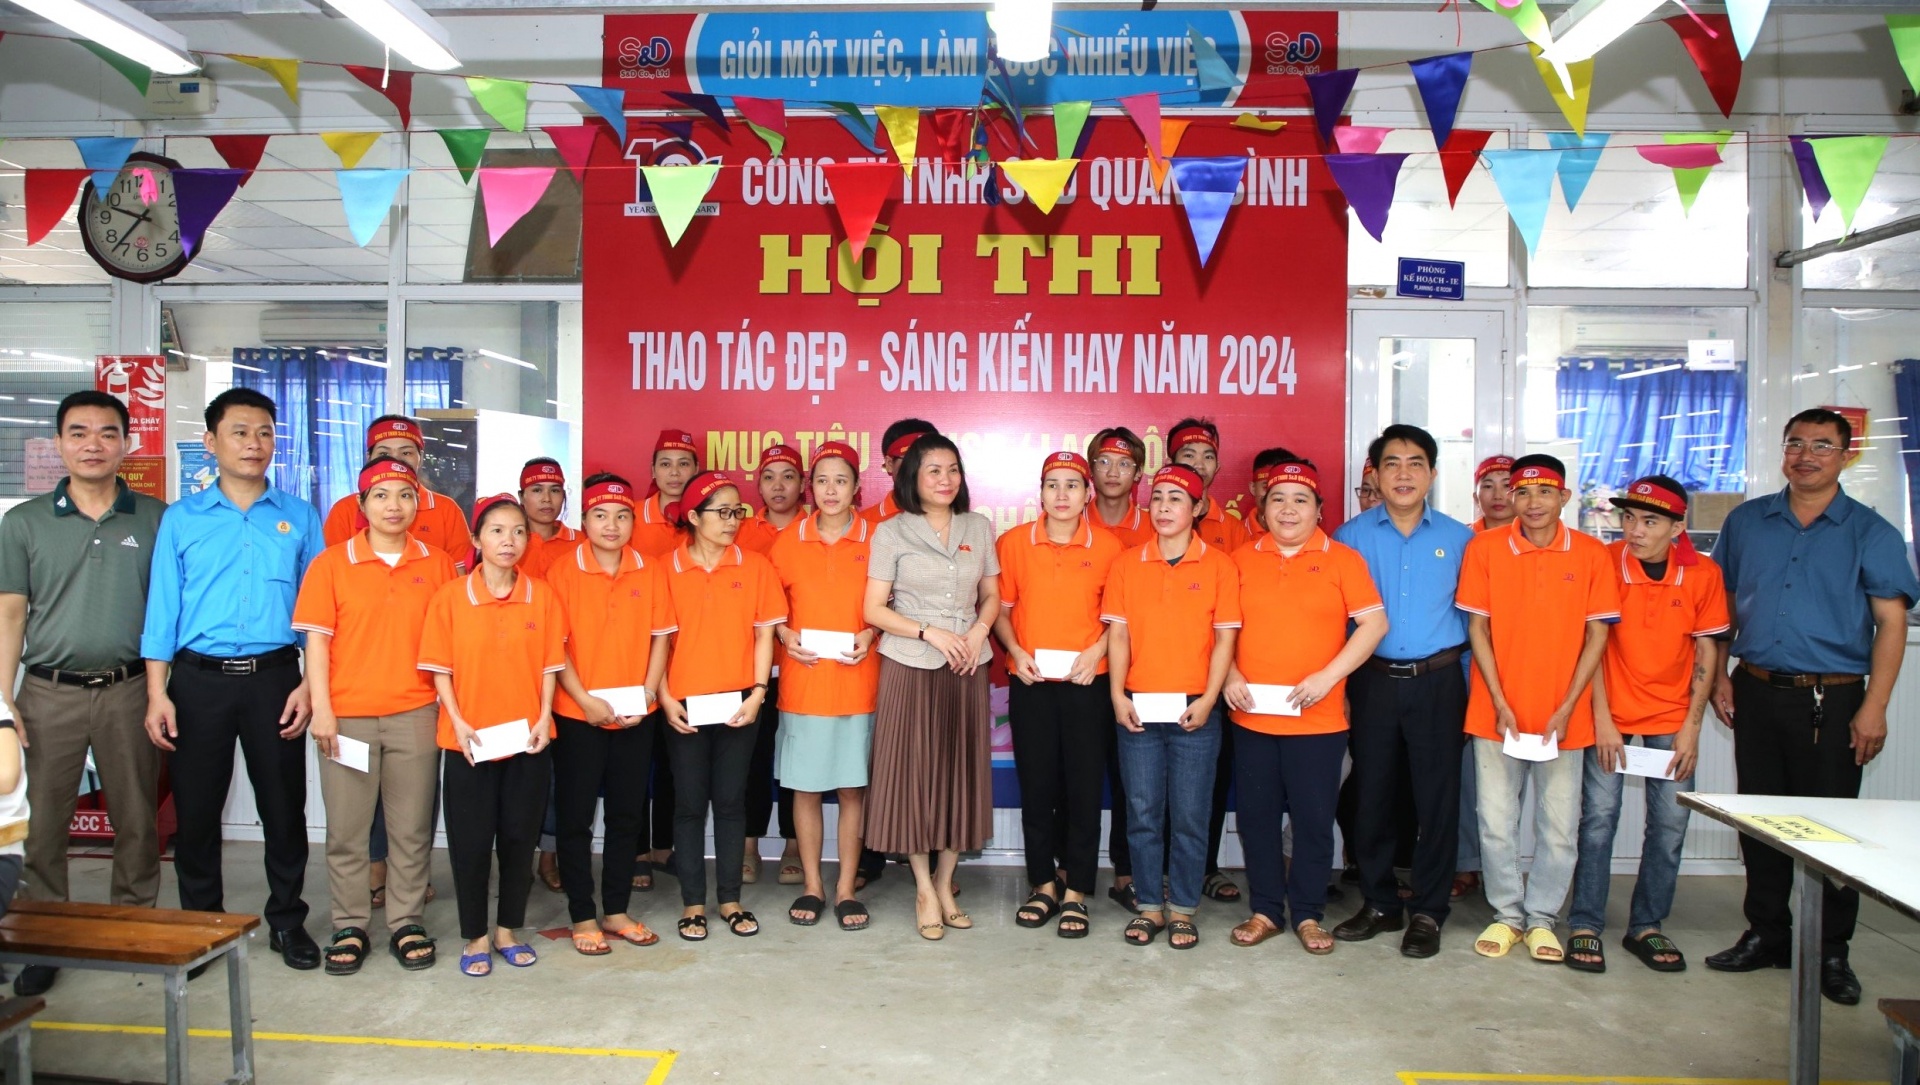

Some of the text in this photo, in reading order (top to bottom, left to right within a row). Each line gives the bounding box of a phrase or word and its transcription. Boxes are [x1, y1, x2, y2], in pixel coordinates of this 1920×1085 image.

[720, 27, 771, 80] GIỎI
[781, 31, 837, 87] MỘT
[845, 30, 912, 87] VIỆC,
[921, 29, 977, 77] LÀM
[1067, 24, 1148, 77] NHIỀU
[1157, 28, 1217, 86] VIỆ
[620, 69, 636, 78] S&D
[1267, 66, 1284, 75] S&D
[1229, 147, 1308, 207] ÌNH
[120, 179, 131, 193] 11
[160, 179, 165, 194] 1
[100, 210, 112, 225] 9
[106, 229, 118, 243] 8
[168, 229, 181, 244] 4
[120, 242, 131, 257] 7
[137, 248, 149, 262] 6
[155, 243, 167, 257] 5
[759, 222, 1161, 306] HỘI THI
[1417, 264, 1446, 274] PHÒNG
[1403, 272, 1415, 282] KẾ
[1416, 275, 1445, 285] HOẠCH
[1450, 277, 1459, 285] IE
[628, 312, 1297, 405] THAO TÁC ĐẸP - SÁNG KIẾN HAY NĂM 2024
[1573, 938, 1599, 951] RUN
